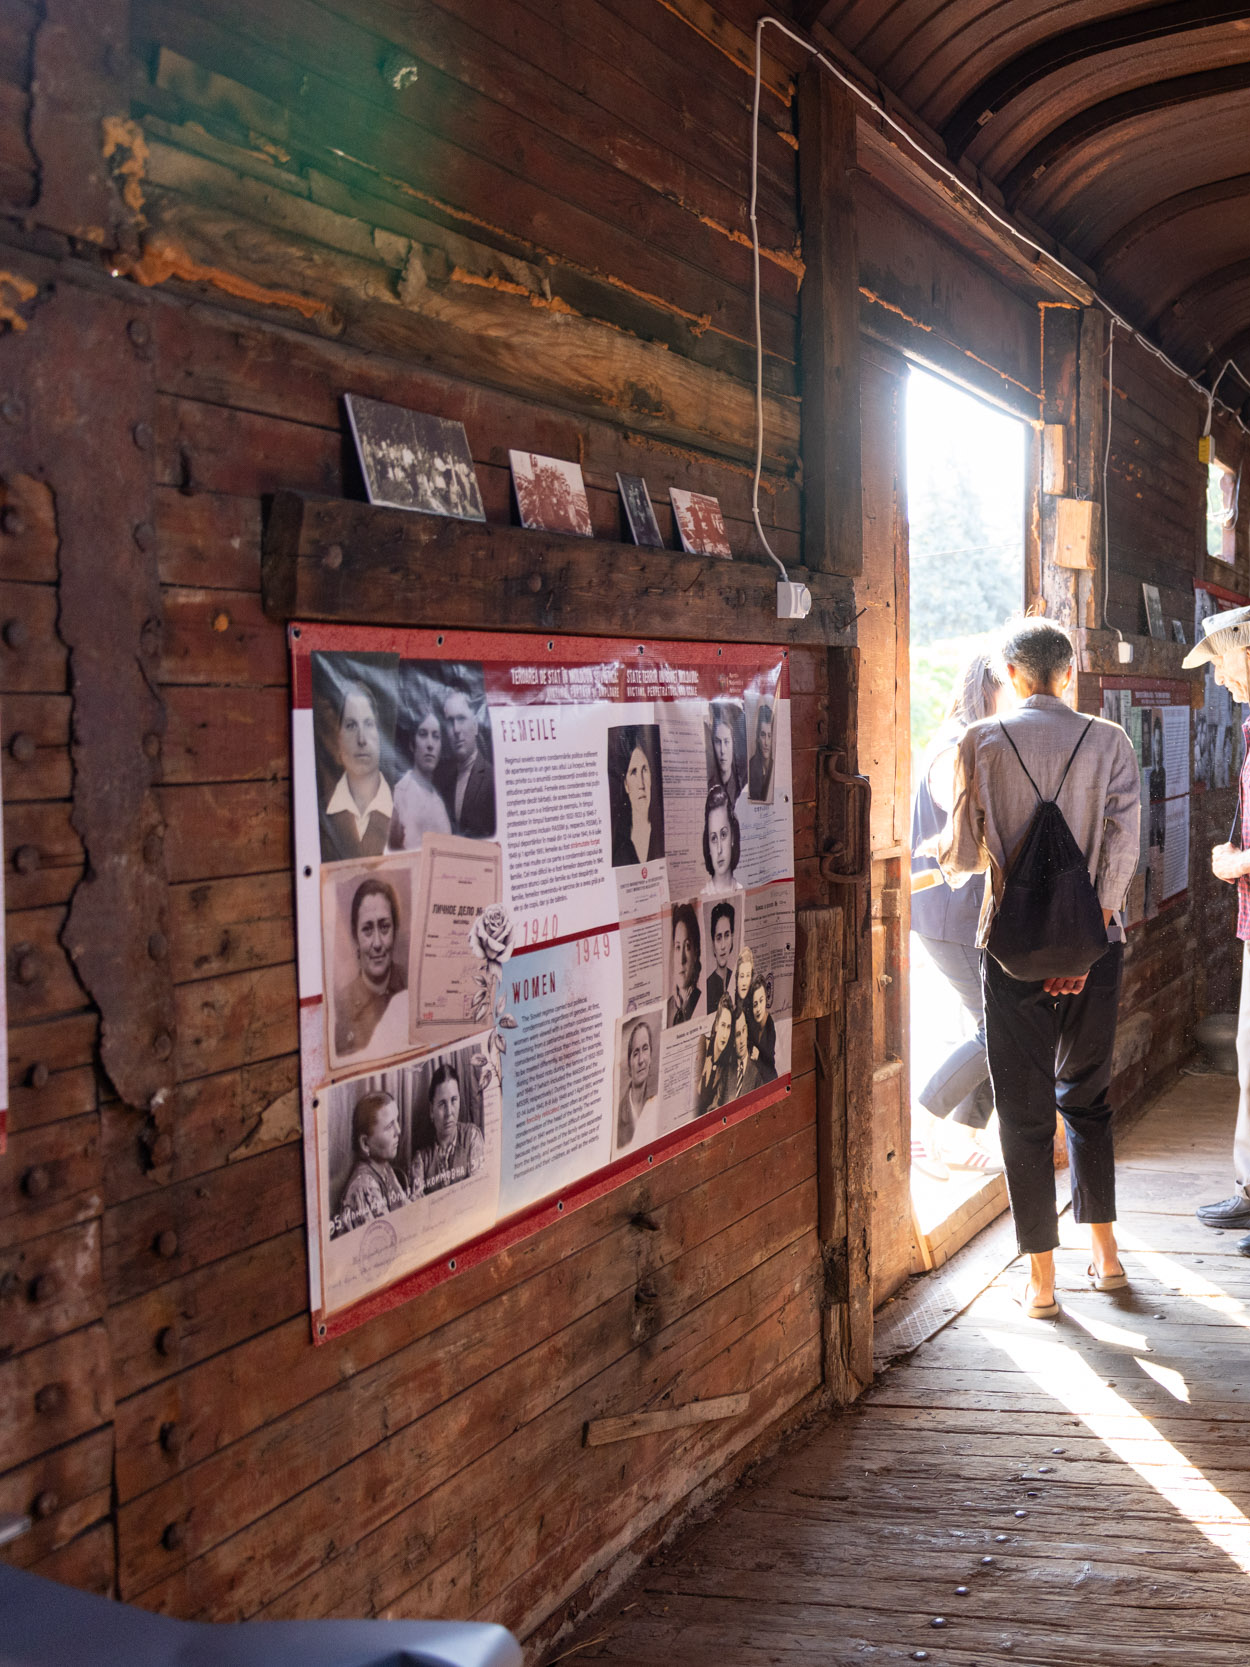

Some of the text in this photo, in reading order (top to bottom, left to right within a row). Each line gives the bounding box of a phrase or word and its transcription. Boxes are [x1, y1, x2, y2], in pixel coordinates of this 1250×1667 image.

[501, 718, 557, 742] FEMEILE
[432, 904, 457, 915] ЛИЧНОЕ
[457, 906, 474, 917] ДЕЛО
[523, 914, 558, 946] 1940
[576, 933, 610, 965] 1949
[512, 971, 556, 1004] WOMEN
